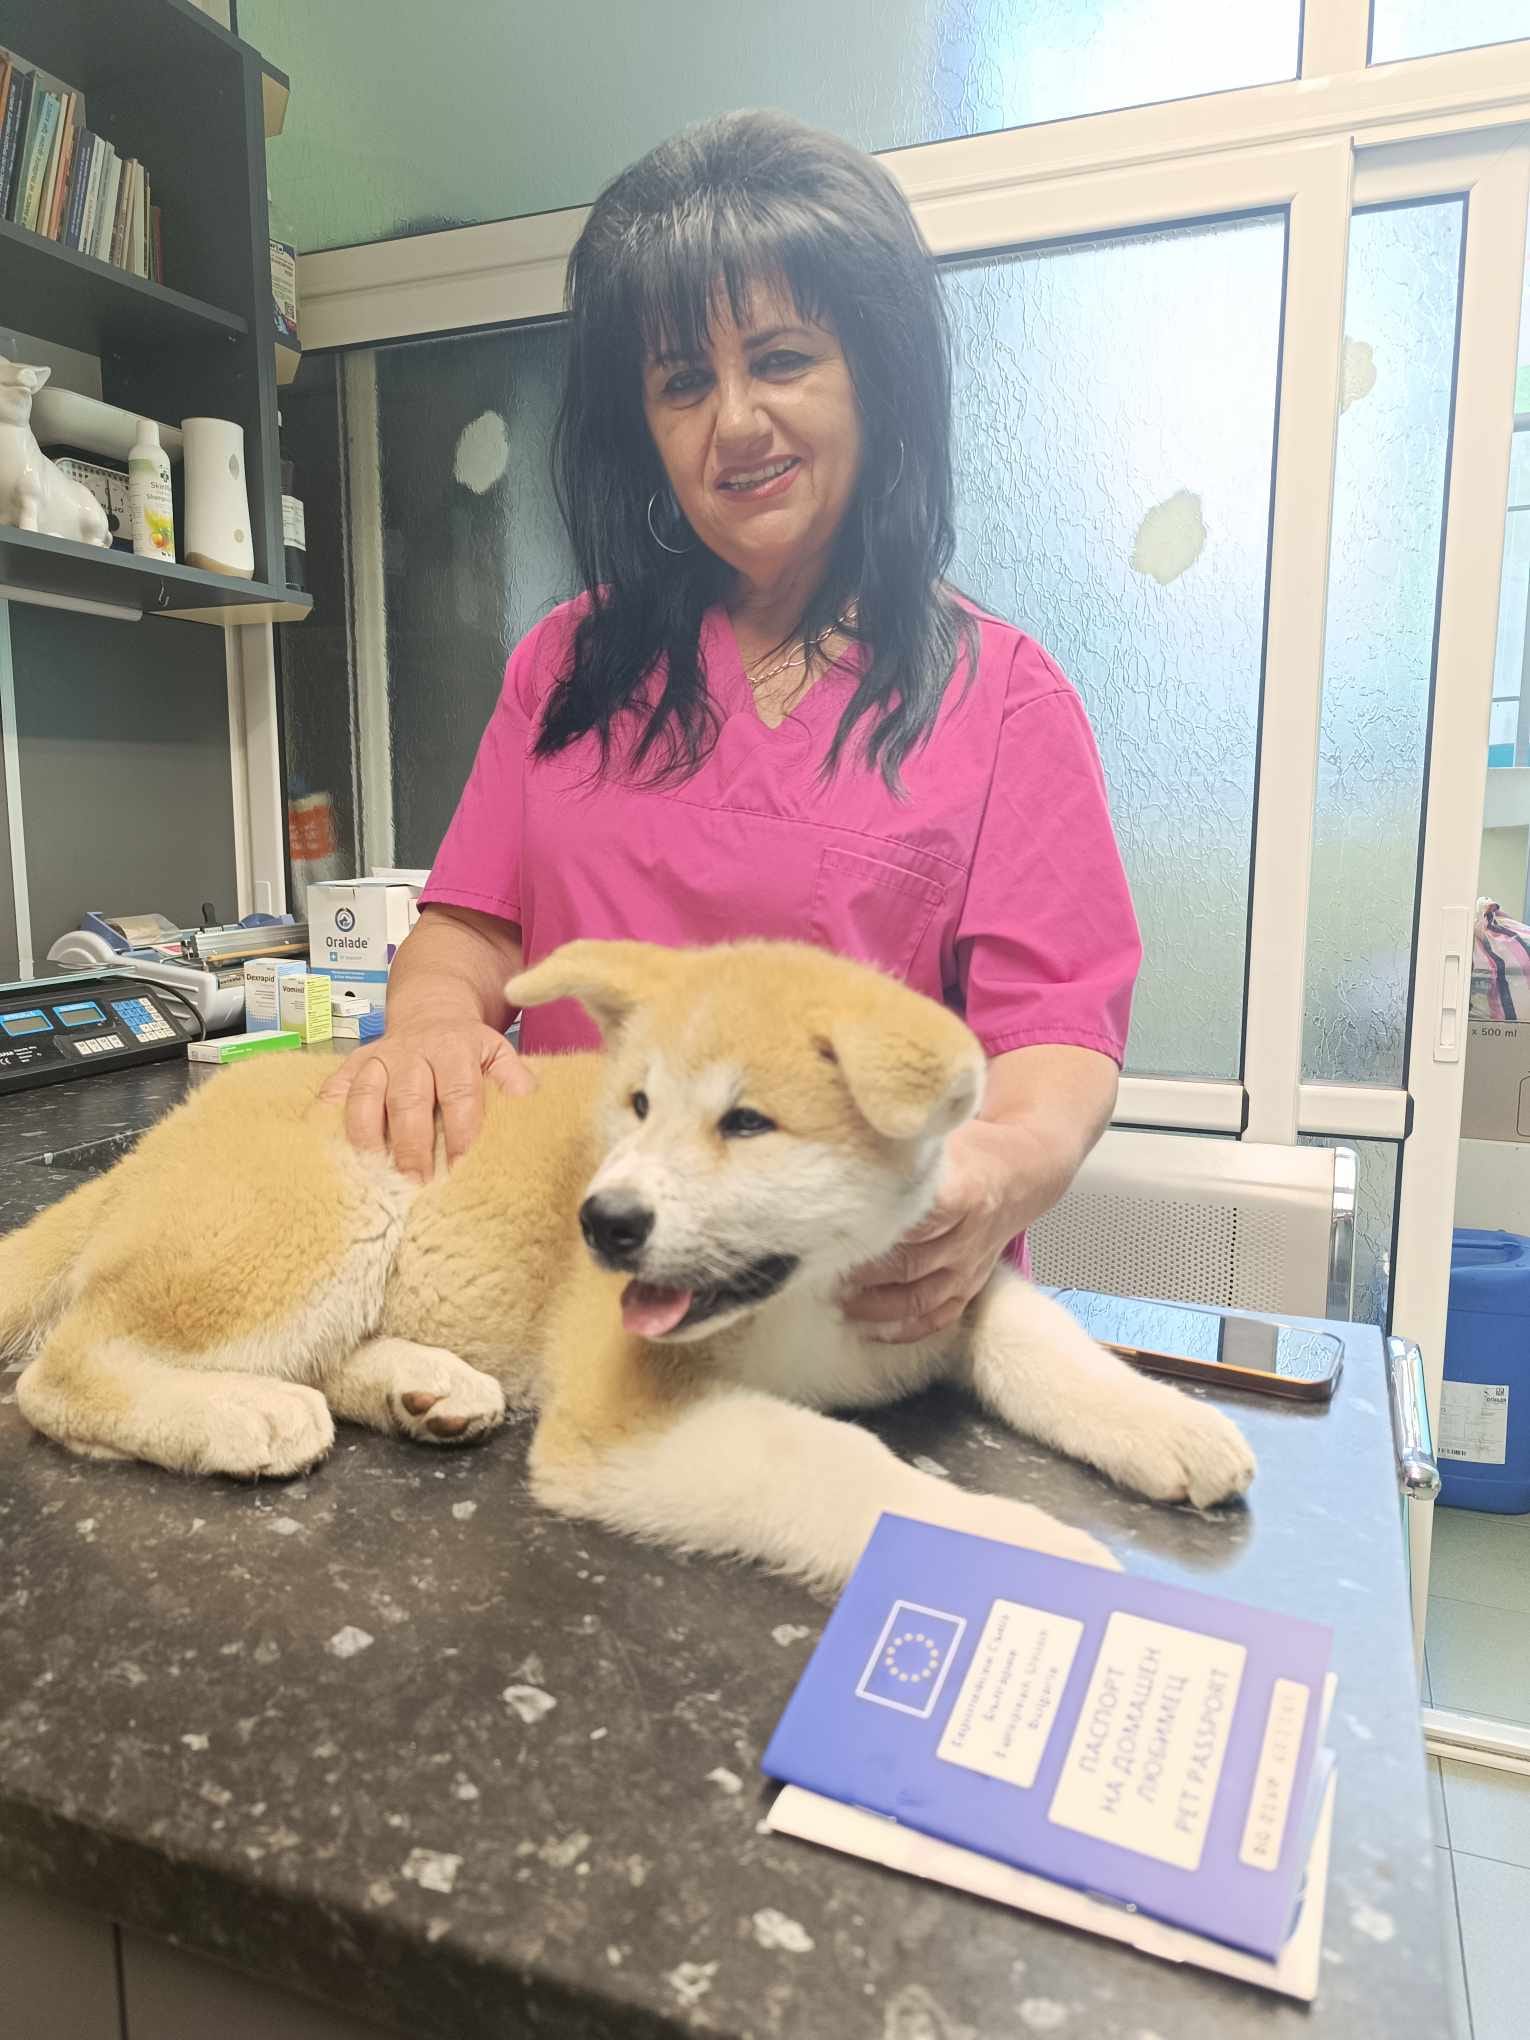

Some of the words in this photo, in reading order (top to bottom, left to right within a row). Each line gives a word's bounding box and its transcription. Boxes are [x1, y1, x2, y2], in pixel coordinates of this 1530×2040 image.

[326, 936, 368, 949] Oralade
[1481, 1027, 1501, 1037] 500
[1504, 1029, 1518, 1038] ml
[1078, 1665, 1125, 1774] ПАСПОРТ
[1112, 1647, 1161, 1776] ДОМАШЕН
[1136, 1674, 1191, 1805] ЛЮБИМЕЦ
[1186, 1667, 1230, 1785] PASSPORT
[1100, 1780, 1126, 1815] НА
[1174, 1789, 1202, 1835] PET
